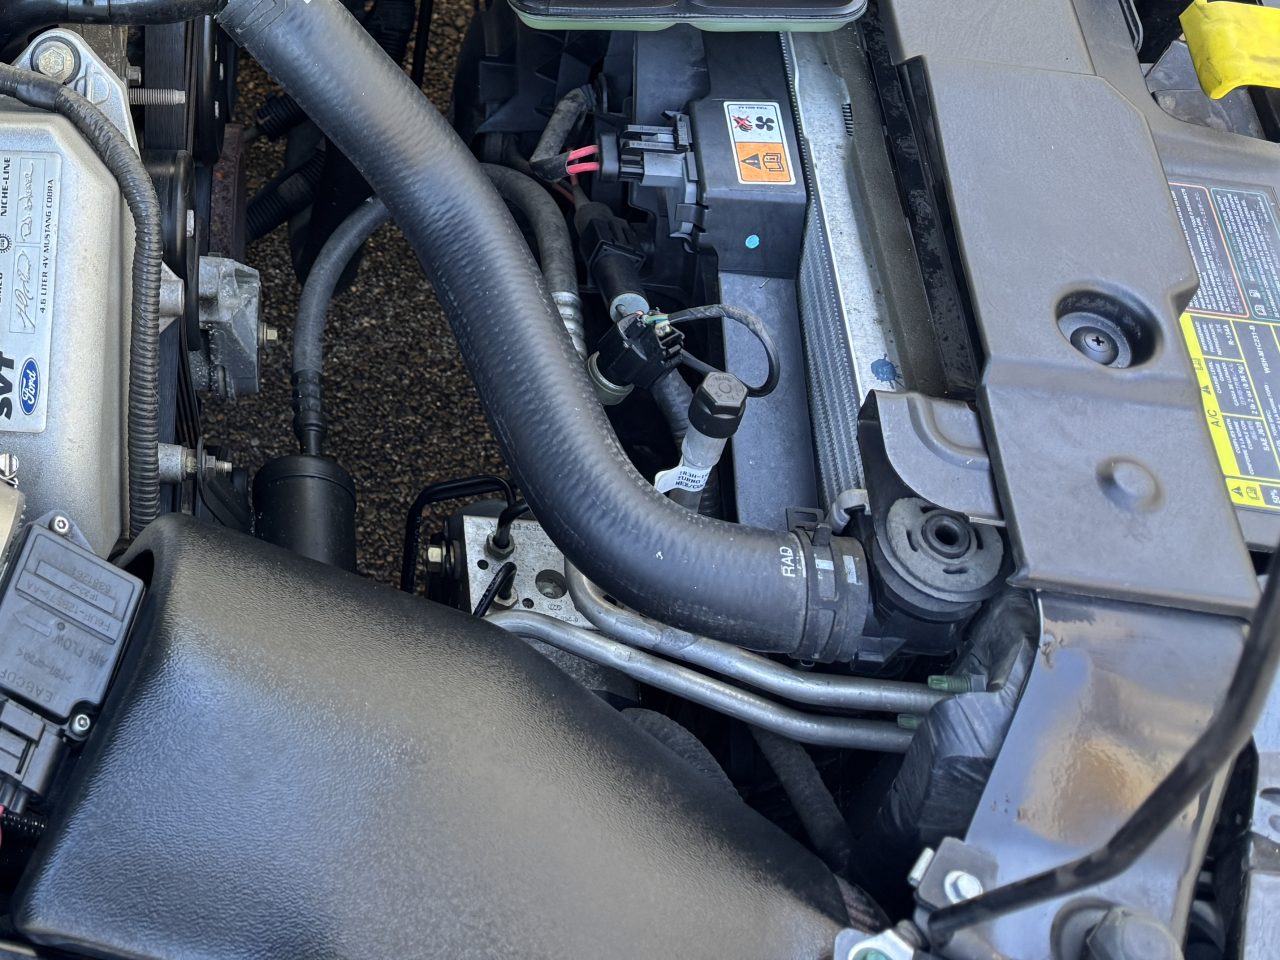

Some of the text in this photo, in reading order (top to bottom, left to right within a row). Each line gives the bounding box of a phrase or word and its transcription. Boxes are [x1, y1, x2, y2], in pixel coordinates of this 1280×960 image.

[0, 157, 11, 217] NICHE-LINE
[45, 179, 54, 209] COBRA
[43, 211, 52, 253] MUSTANG
[39, 297, 47, 314] 4.6
[22, 369, 36, 404] Ford
[1206, 408, 1221, 427] A/C
[1259, 436, 1270, 451] SAE
[779, 546, 796, 578] RAD
[54, 634, 110, 669] AIR FLOW
